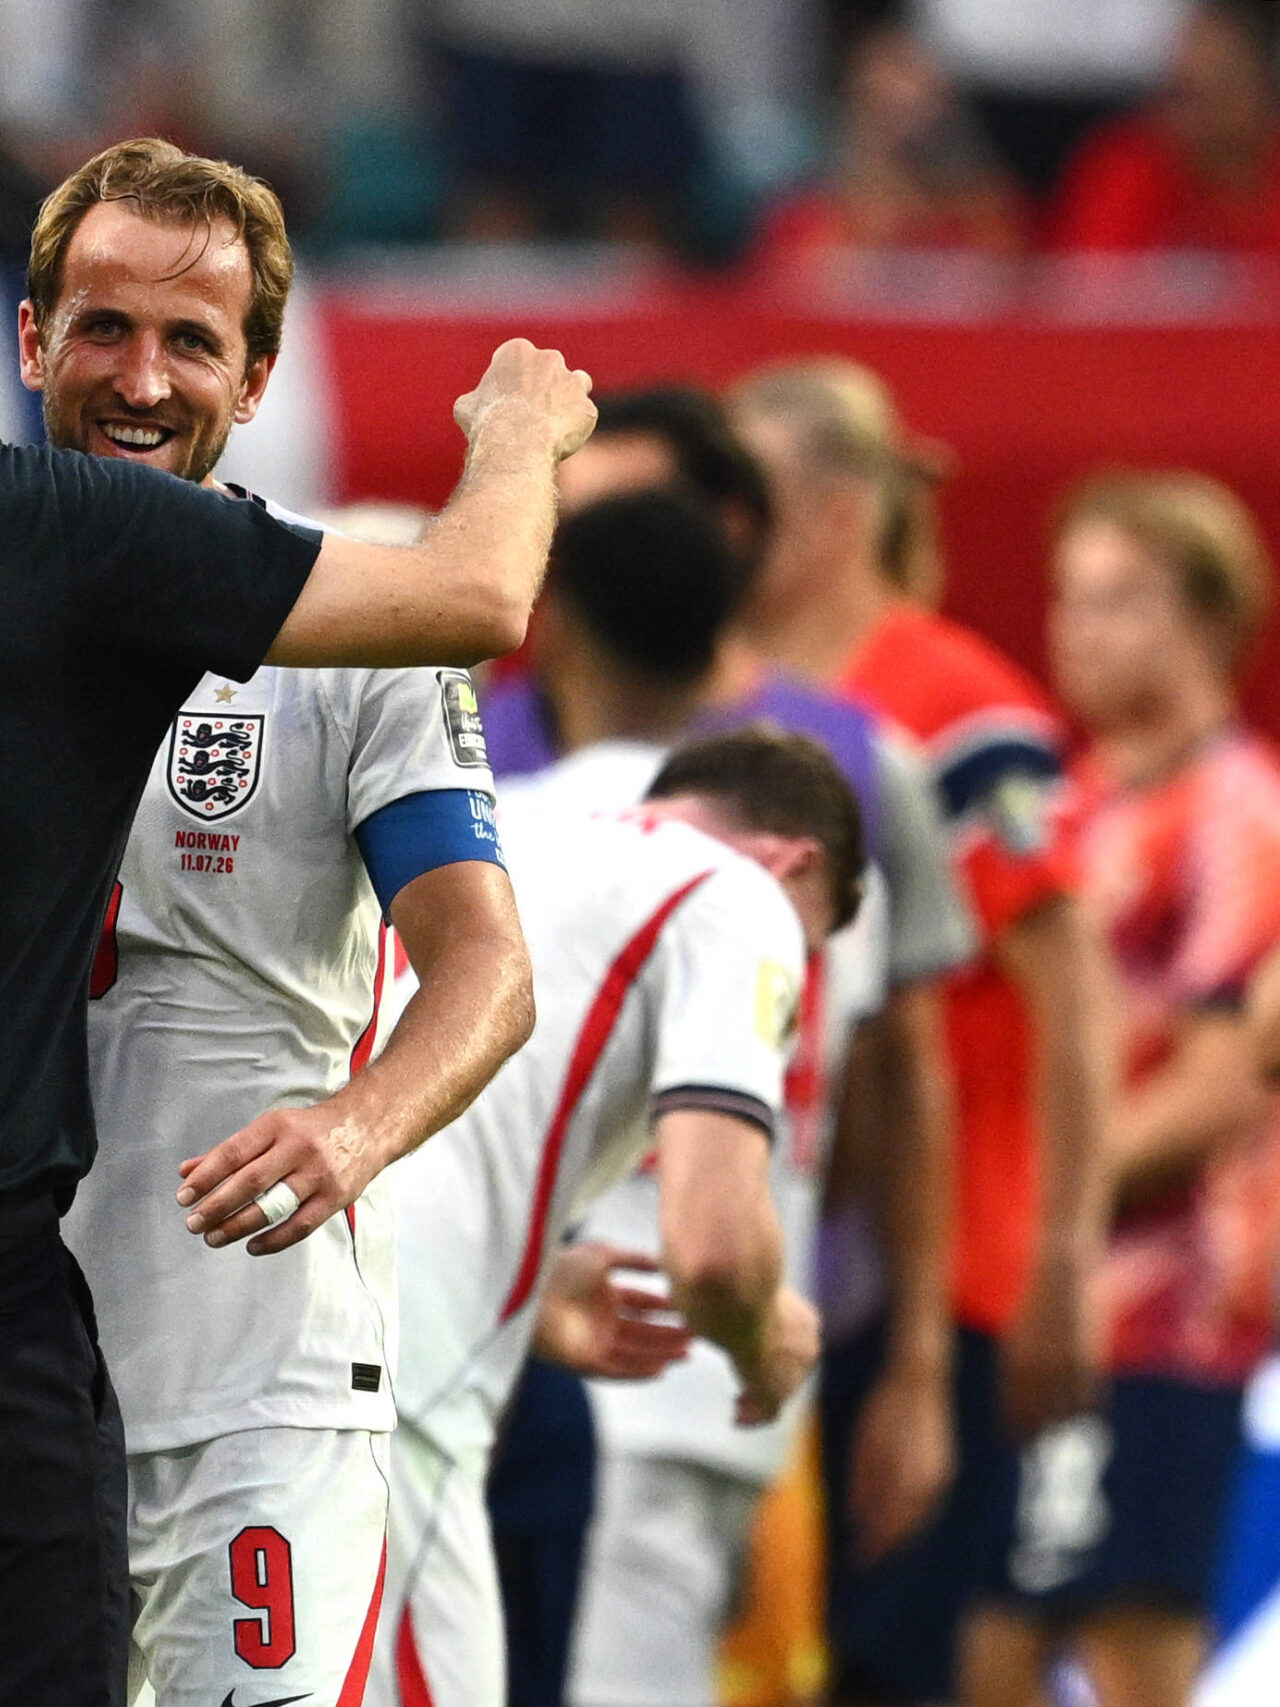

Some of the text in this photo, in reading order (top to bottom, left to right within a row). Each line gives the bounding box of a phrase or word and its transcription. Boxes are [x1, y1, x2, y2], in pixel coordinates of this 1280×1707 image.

[175, 831, 240, 852] NORWAY
[181, 854, 234, 874] 11.07.26
[229, 1526, 296, 1669] 9
